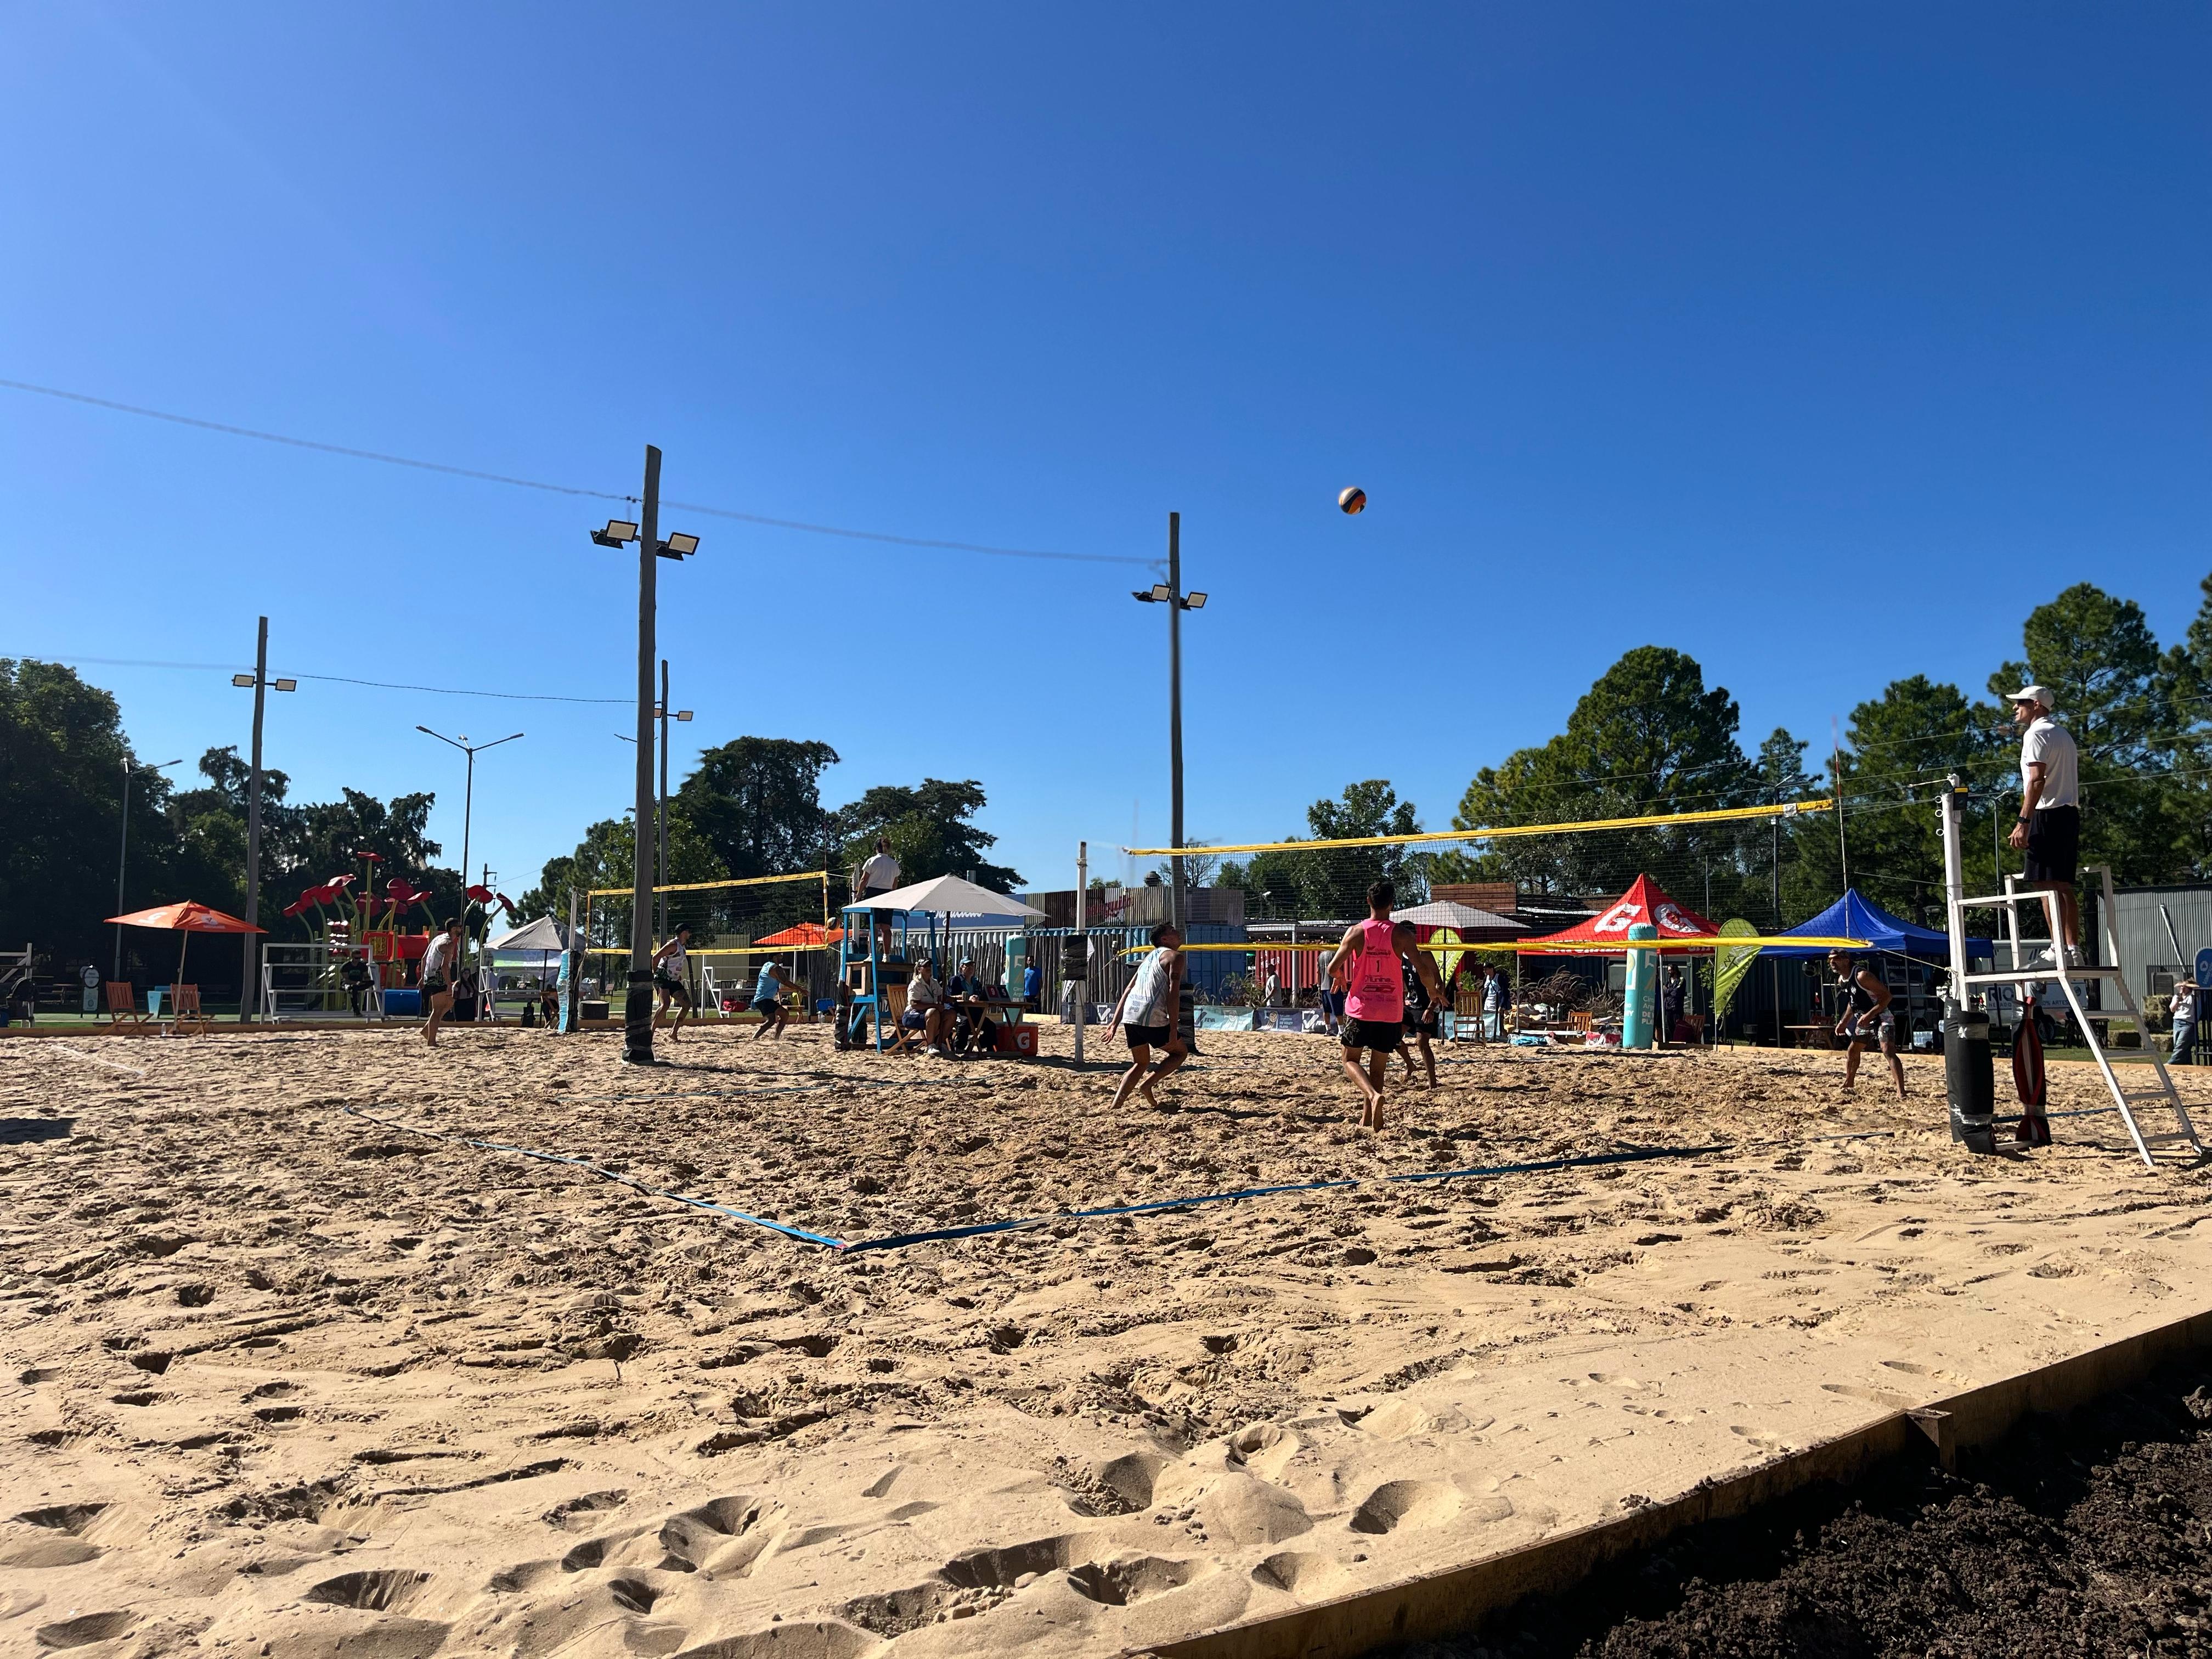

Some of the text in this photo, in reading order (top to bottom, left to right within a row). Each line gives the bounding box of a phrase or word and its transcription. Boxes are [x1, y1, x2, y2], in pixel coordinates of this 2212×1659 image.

[1594, 903, 1642, 933] G
[1376, 960, 1380, 973] 1
[1446, 957, 1460, 982] EDADES
[1408, 973, 1413, 981] 2
[1723, 953, 1756, 1001] PROPIEDADES
[1988, 987, 2014, 1001] RIO
[1017, 1032, 1030, 1049] G
